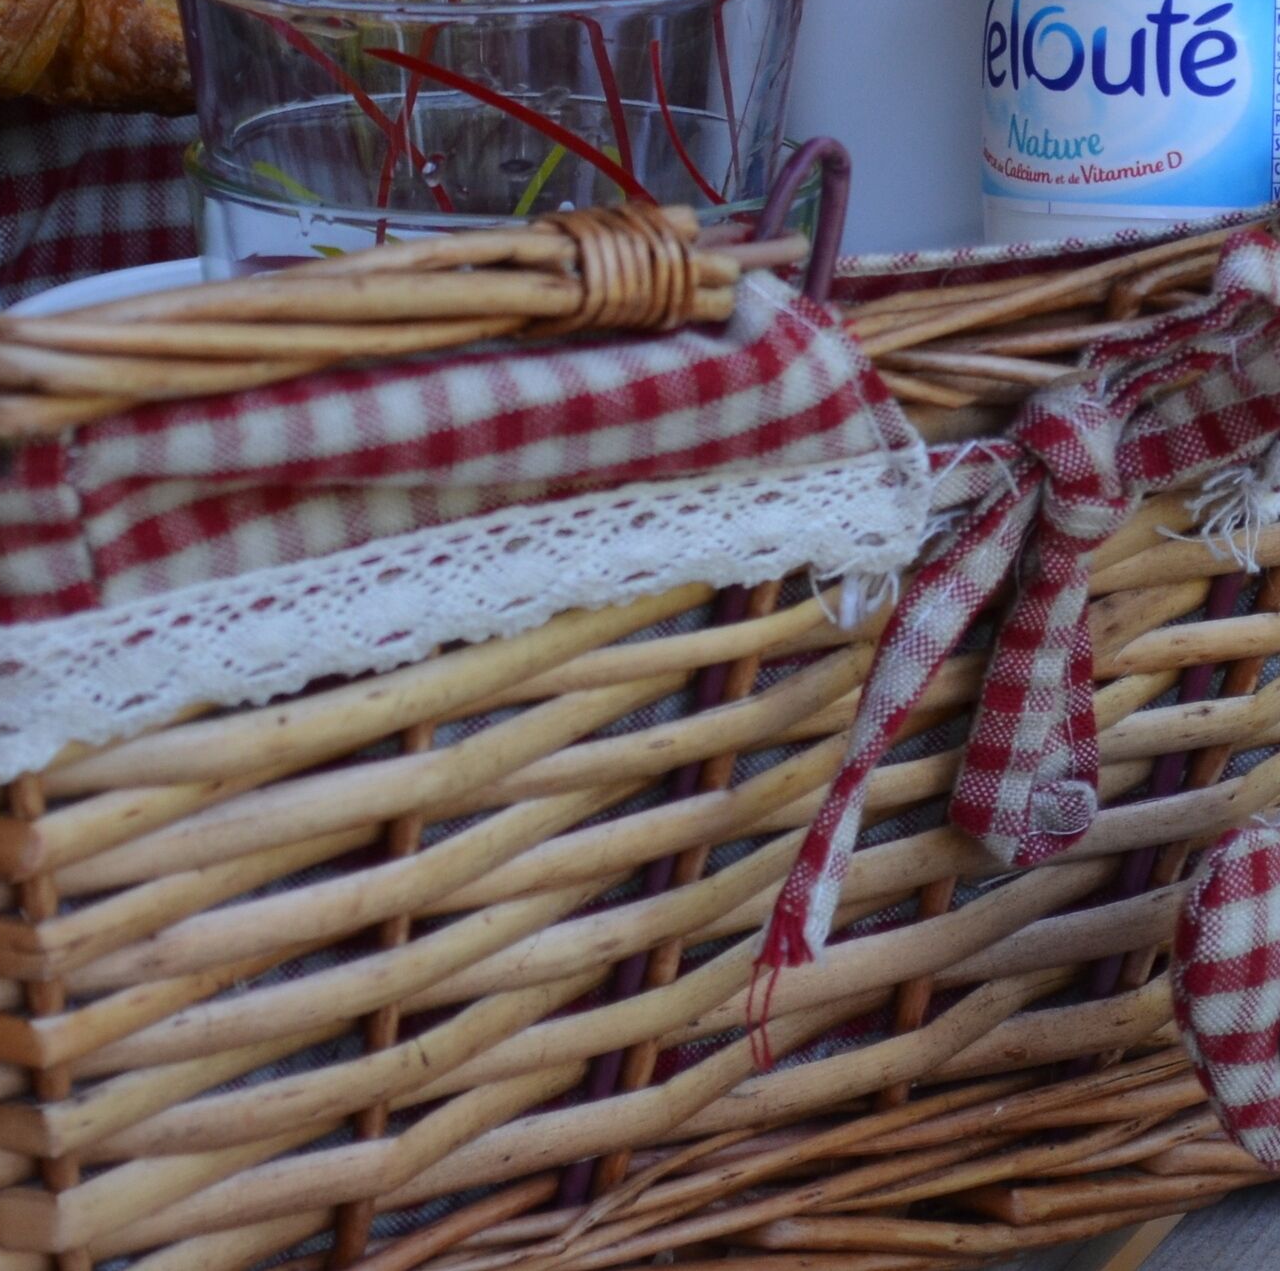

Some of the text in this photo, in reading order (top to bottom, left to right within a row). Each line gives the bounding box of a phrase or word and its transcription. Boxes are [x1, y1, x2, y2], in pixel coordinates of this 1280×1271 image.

[1007, 114, 1105, 160] Nature
[1004, 157, 1053, 184] Calcium
[1055, 174, 1065, 185] et
[1068, 173, 1080, 185] de
[1080, 160, 1164, 185] Vitamine
[1166, 151, 1183, 170] D
